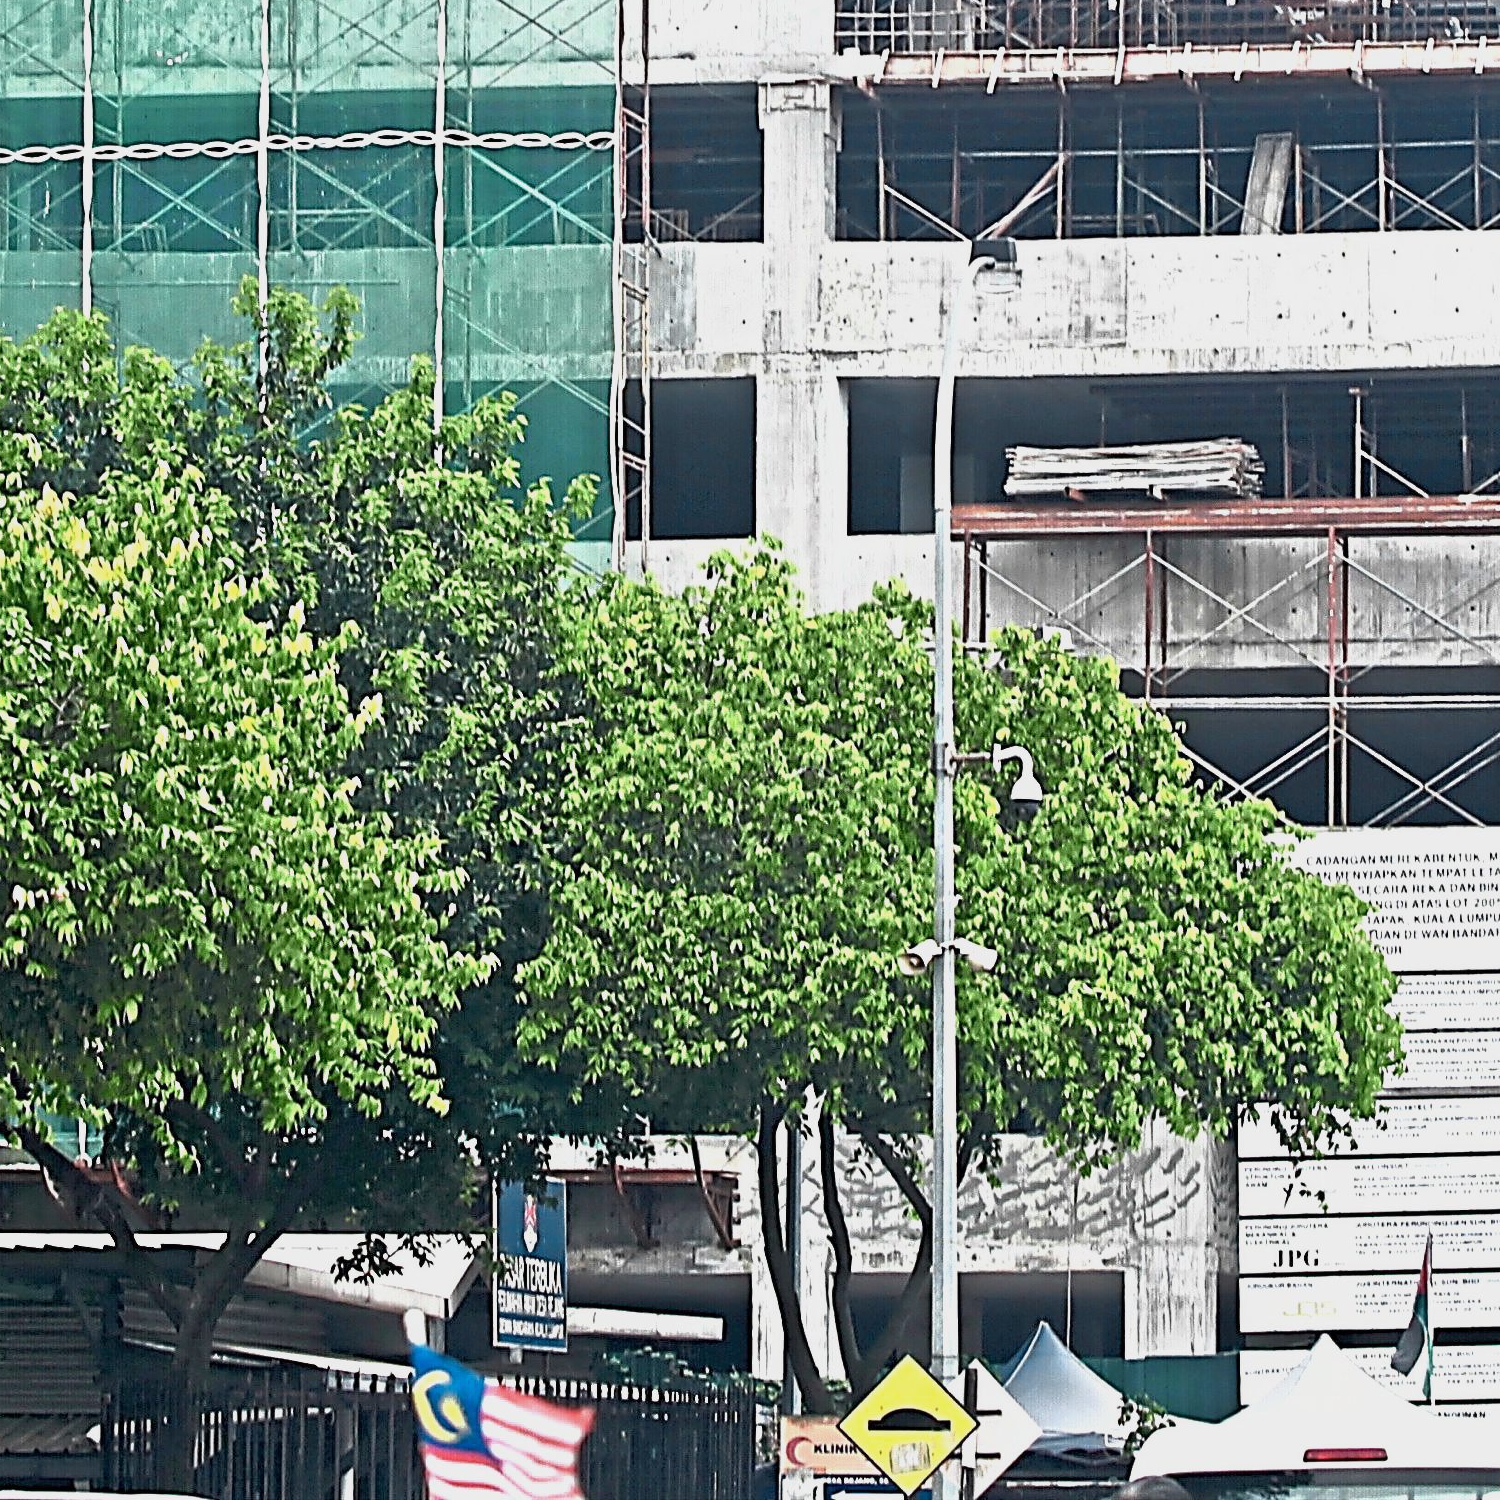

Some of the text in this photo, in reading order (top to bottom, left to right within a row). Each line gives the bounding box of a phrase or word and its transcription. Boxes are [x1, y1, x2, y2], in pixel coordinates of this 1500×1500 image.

[1306, 854, 1376, 867] CADANGAN
[1422, 867, 1467, 878] TEMPAT
[1412, 883, 1446, 895] REKA
[1450, 882, 1476, 893] DAN
[1396, 898, 1408, 910] DI
[1412, 898, 1443, 909] ATAS
[1445, 897, 1468, 908] LOT
[1414, 913, 1455, 924] KUALA
[1404, 928, 1449, 940] DEWAN
[1273, 1249, 1319, 1268] JPG
[525, 1256, 563, 1296] TERBUKA
[813, 1443, 858, 1454] KLINIK
